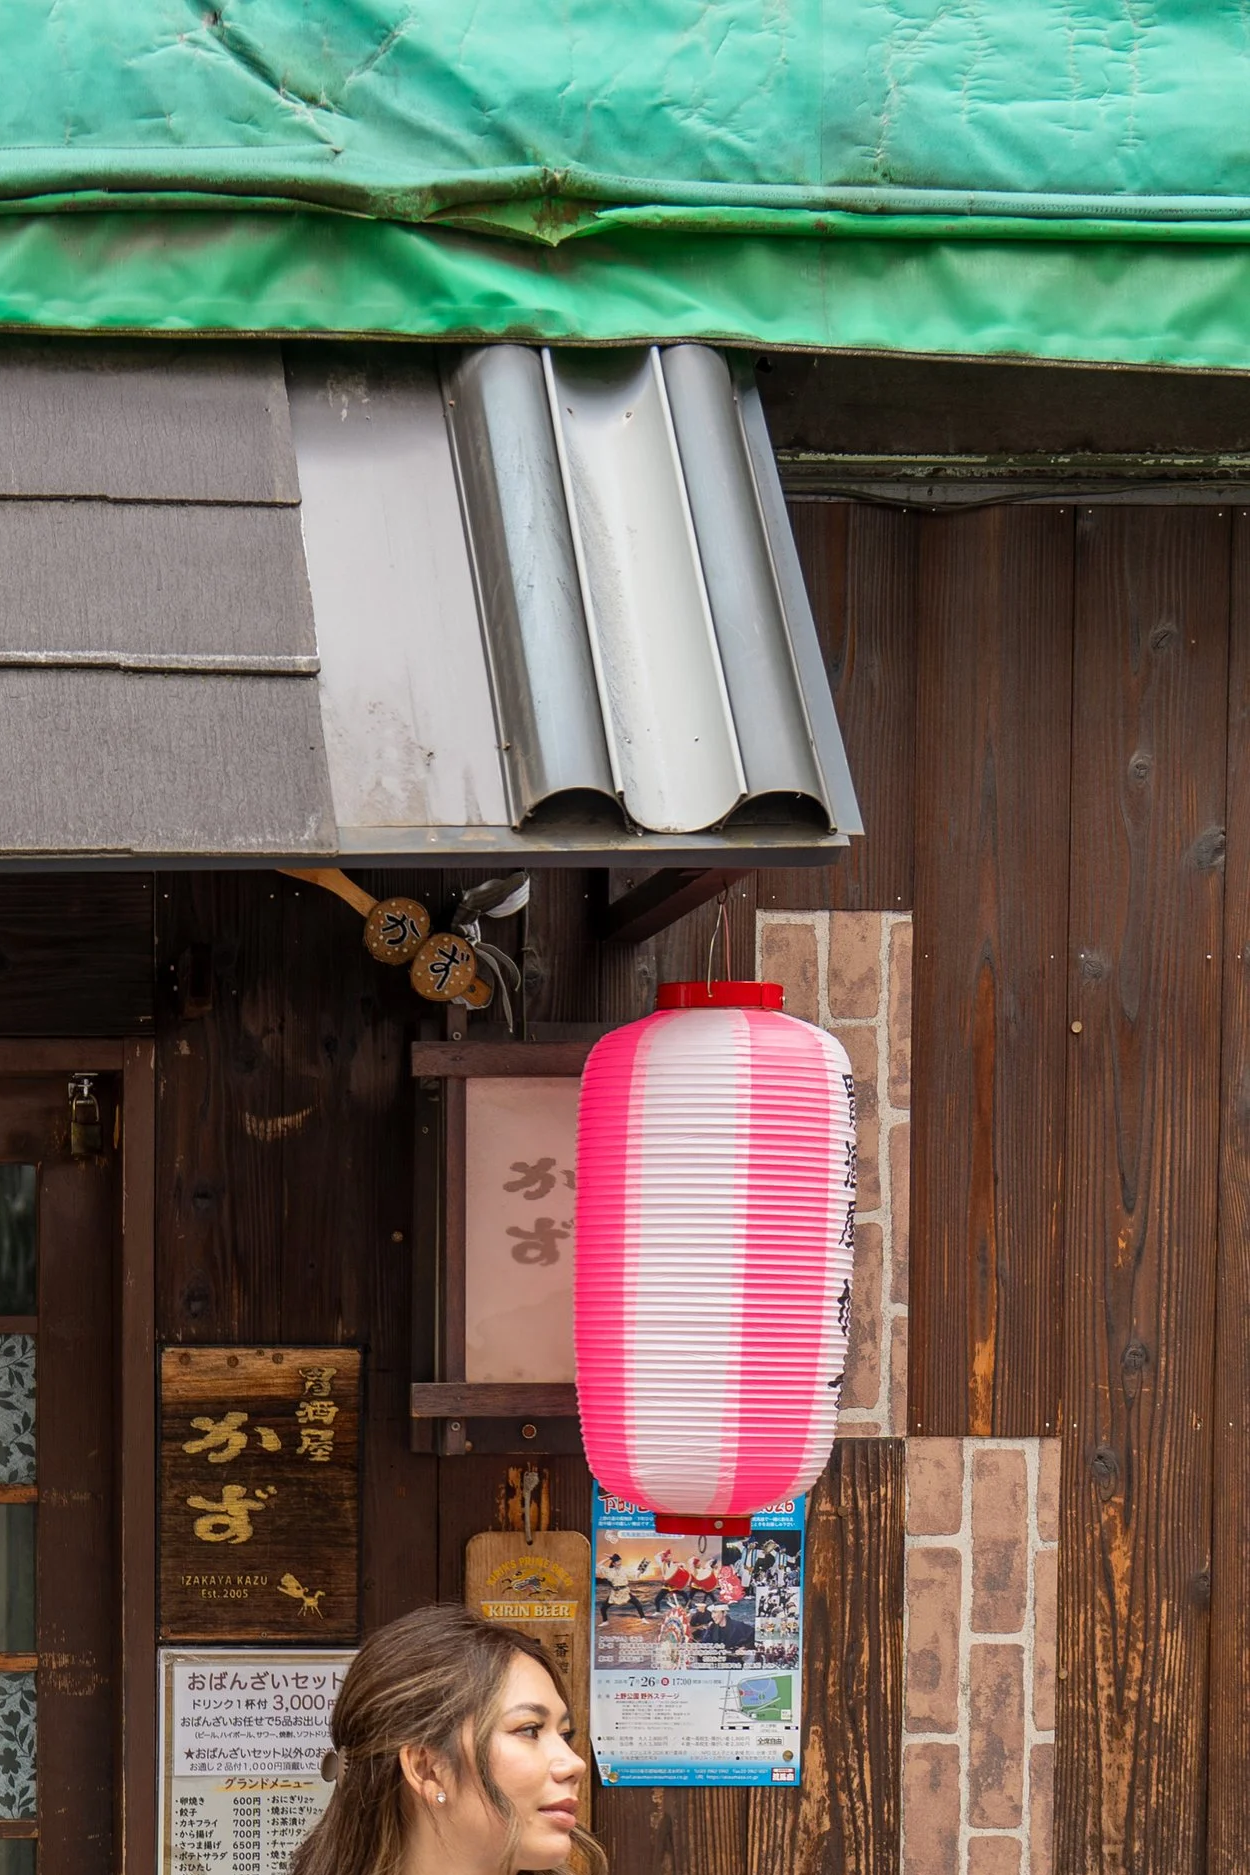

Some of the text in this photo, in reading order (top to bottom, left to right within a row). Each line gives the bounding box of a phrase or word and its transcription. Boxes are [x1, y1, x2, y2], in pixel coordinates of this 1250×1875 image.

[502, 1157, 575, 1267] かず
[182, 1411, 282, 1544] かず
[181, 1575, 269, 1586] IZAKAYA KAZU
[201, 1589, 249, 1599] Est. 2005
[489, 1606, 570, 1617] KIRIN BEER
[187, 1671, 345, 1692] おばんざいセット
[224, 1778, 314, 1790] グランドメニュー
[232, 1797, 261, 1806] 600円
[232, 1808, 261, 1817] 700円
[179, 1819, 261, 1827] カキフライ 700円
[232, 1830, 261, 1839] 700円
[232, 1841, 261, 1849] 650円
[232, 1852, 261, 1861] 500円
[179, 1863, 261, 1872] おひたし 400円
